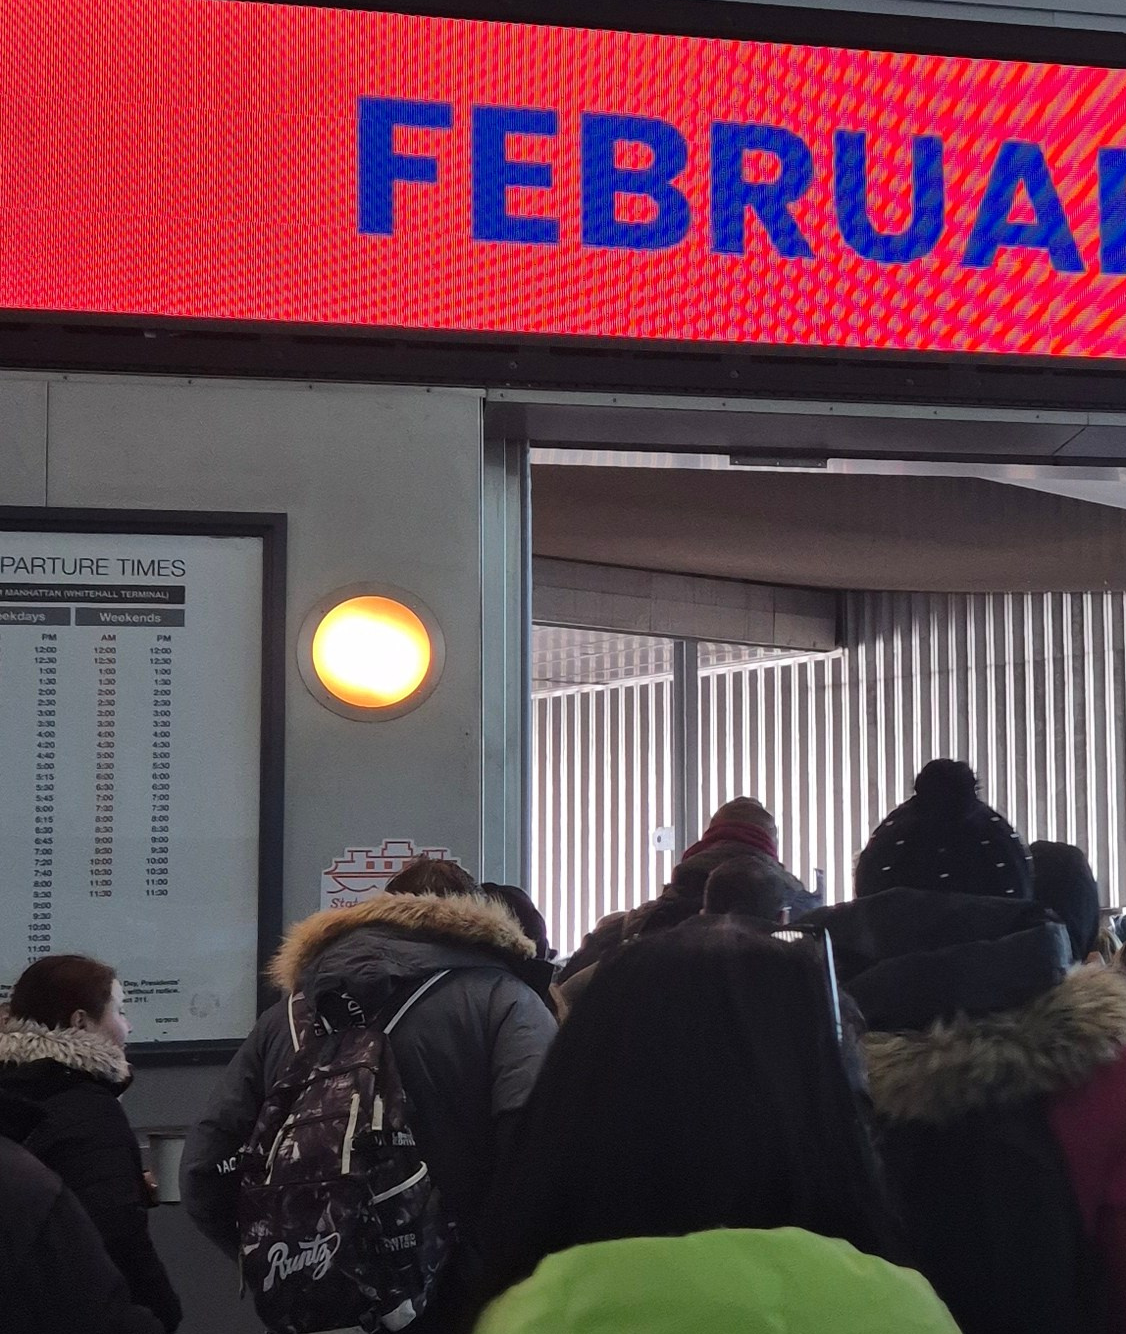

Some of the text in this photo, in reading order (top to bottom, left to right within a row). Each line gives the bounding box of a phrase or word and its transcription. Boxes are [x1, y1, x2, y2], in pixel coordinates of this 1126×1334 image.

[0, 555, 187, 578] PARTURE TIMES
[4, 588, 62, 597] MANHATTAN
[64, 589, 119, 598] (WHITEHALL
[120, 590, 170, 599] TERMINAL)
[99, 612, 162, 623] Weekends
